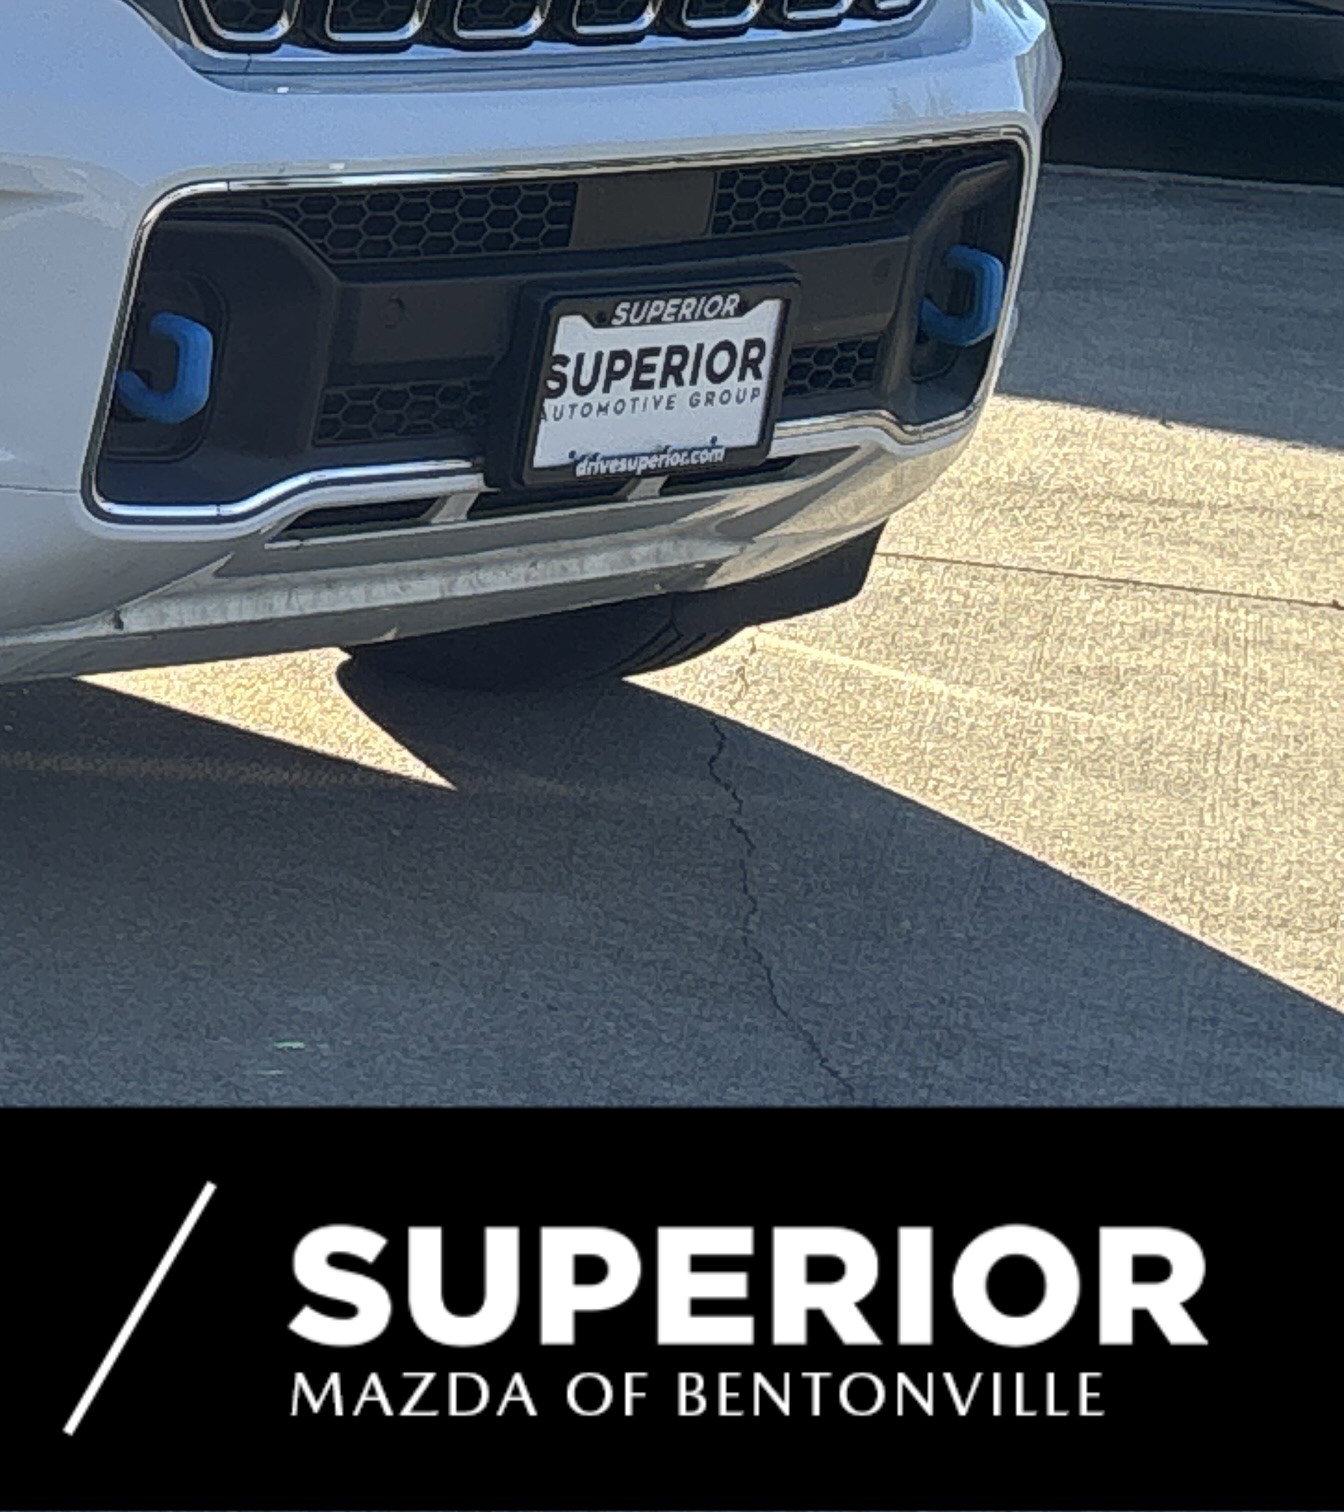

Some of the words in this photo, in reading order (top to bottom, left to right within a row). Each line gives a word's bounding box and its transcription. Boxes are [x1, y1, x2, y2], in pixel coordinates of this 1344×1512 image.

[611, 292, 741, 326] SUPERIOR
[543, 337, 766, 400] SUPERIOR
[539, 392, 677, 423] AUTOMOTIVE
[688, 386, 762, 408] GROUP
[575, 444, 726, 478] drivesuperior.com
